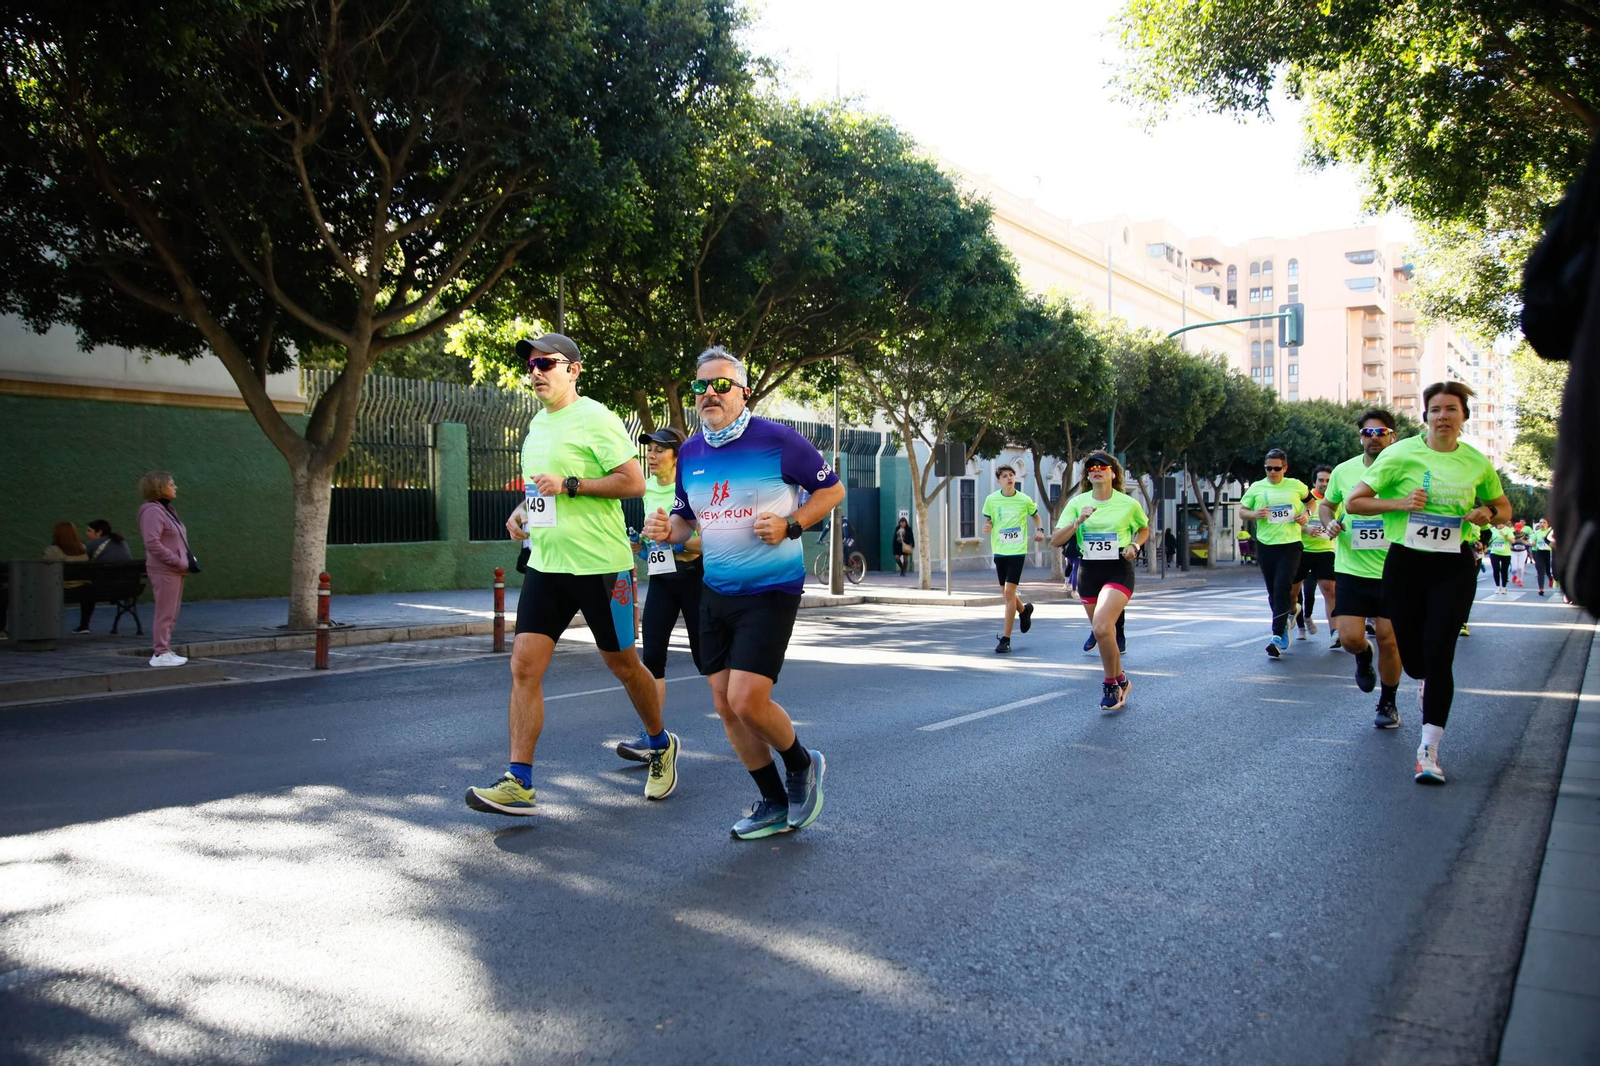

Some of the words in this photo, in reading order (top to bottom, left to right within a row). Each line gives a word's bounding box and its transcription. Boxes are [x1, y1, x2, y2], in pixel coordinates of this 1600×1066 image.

[697, 511, 720, 520] NEW
[724, 507, 753, 519] RUN
[1272, 510, 1289, 518] 385
[1003, 531, 1019, 540] 795
[1359, 529, 1385, 540] 557
[1416, 525, 1451, 541] 419
[1088, 541, 1112, 551] 735
[648, 550, 666, 564] 66
